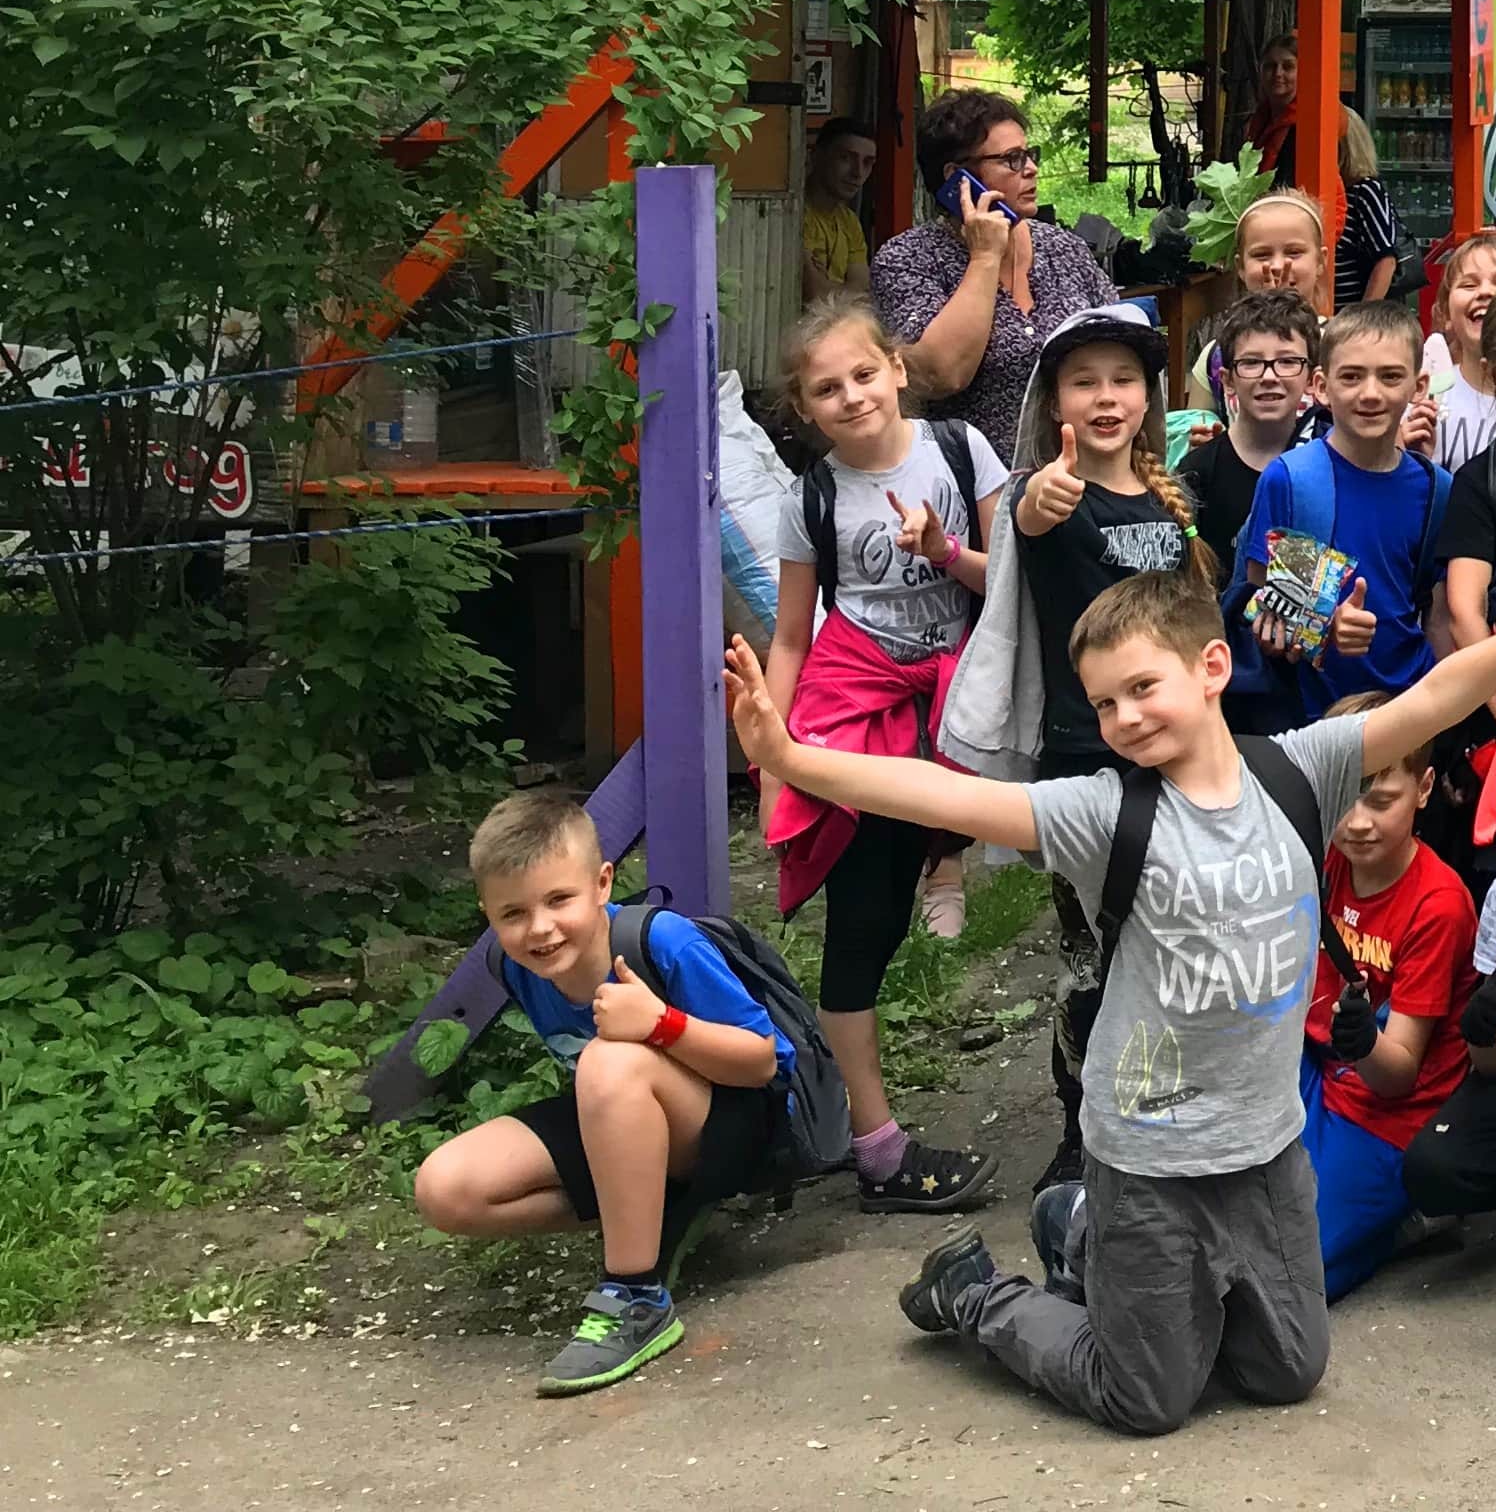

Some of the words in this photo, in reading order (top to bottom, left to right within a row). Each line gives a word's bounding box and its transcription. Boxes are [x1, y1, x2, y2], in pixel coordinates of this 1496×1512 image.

[901, 562, 947, 588] CAN
[864, 591, 963, 628] CHANG
[1145, 841, 1294, 916] CATCH
[1210, 920, 1238, 936] THE
[1156, 930, 1298, 1015] WAVE
